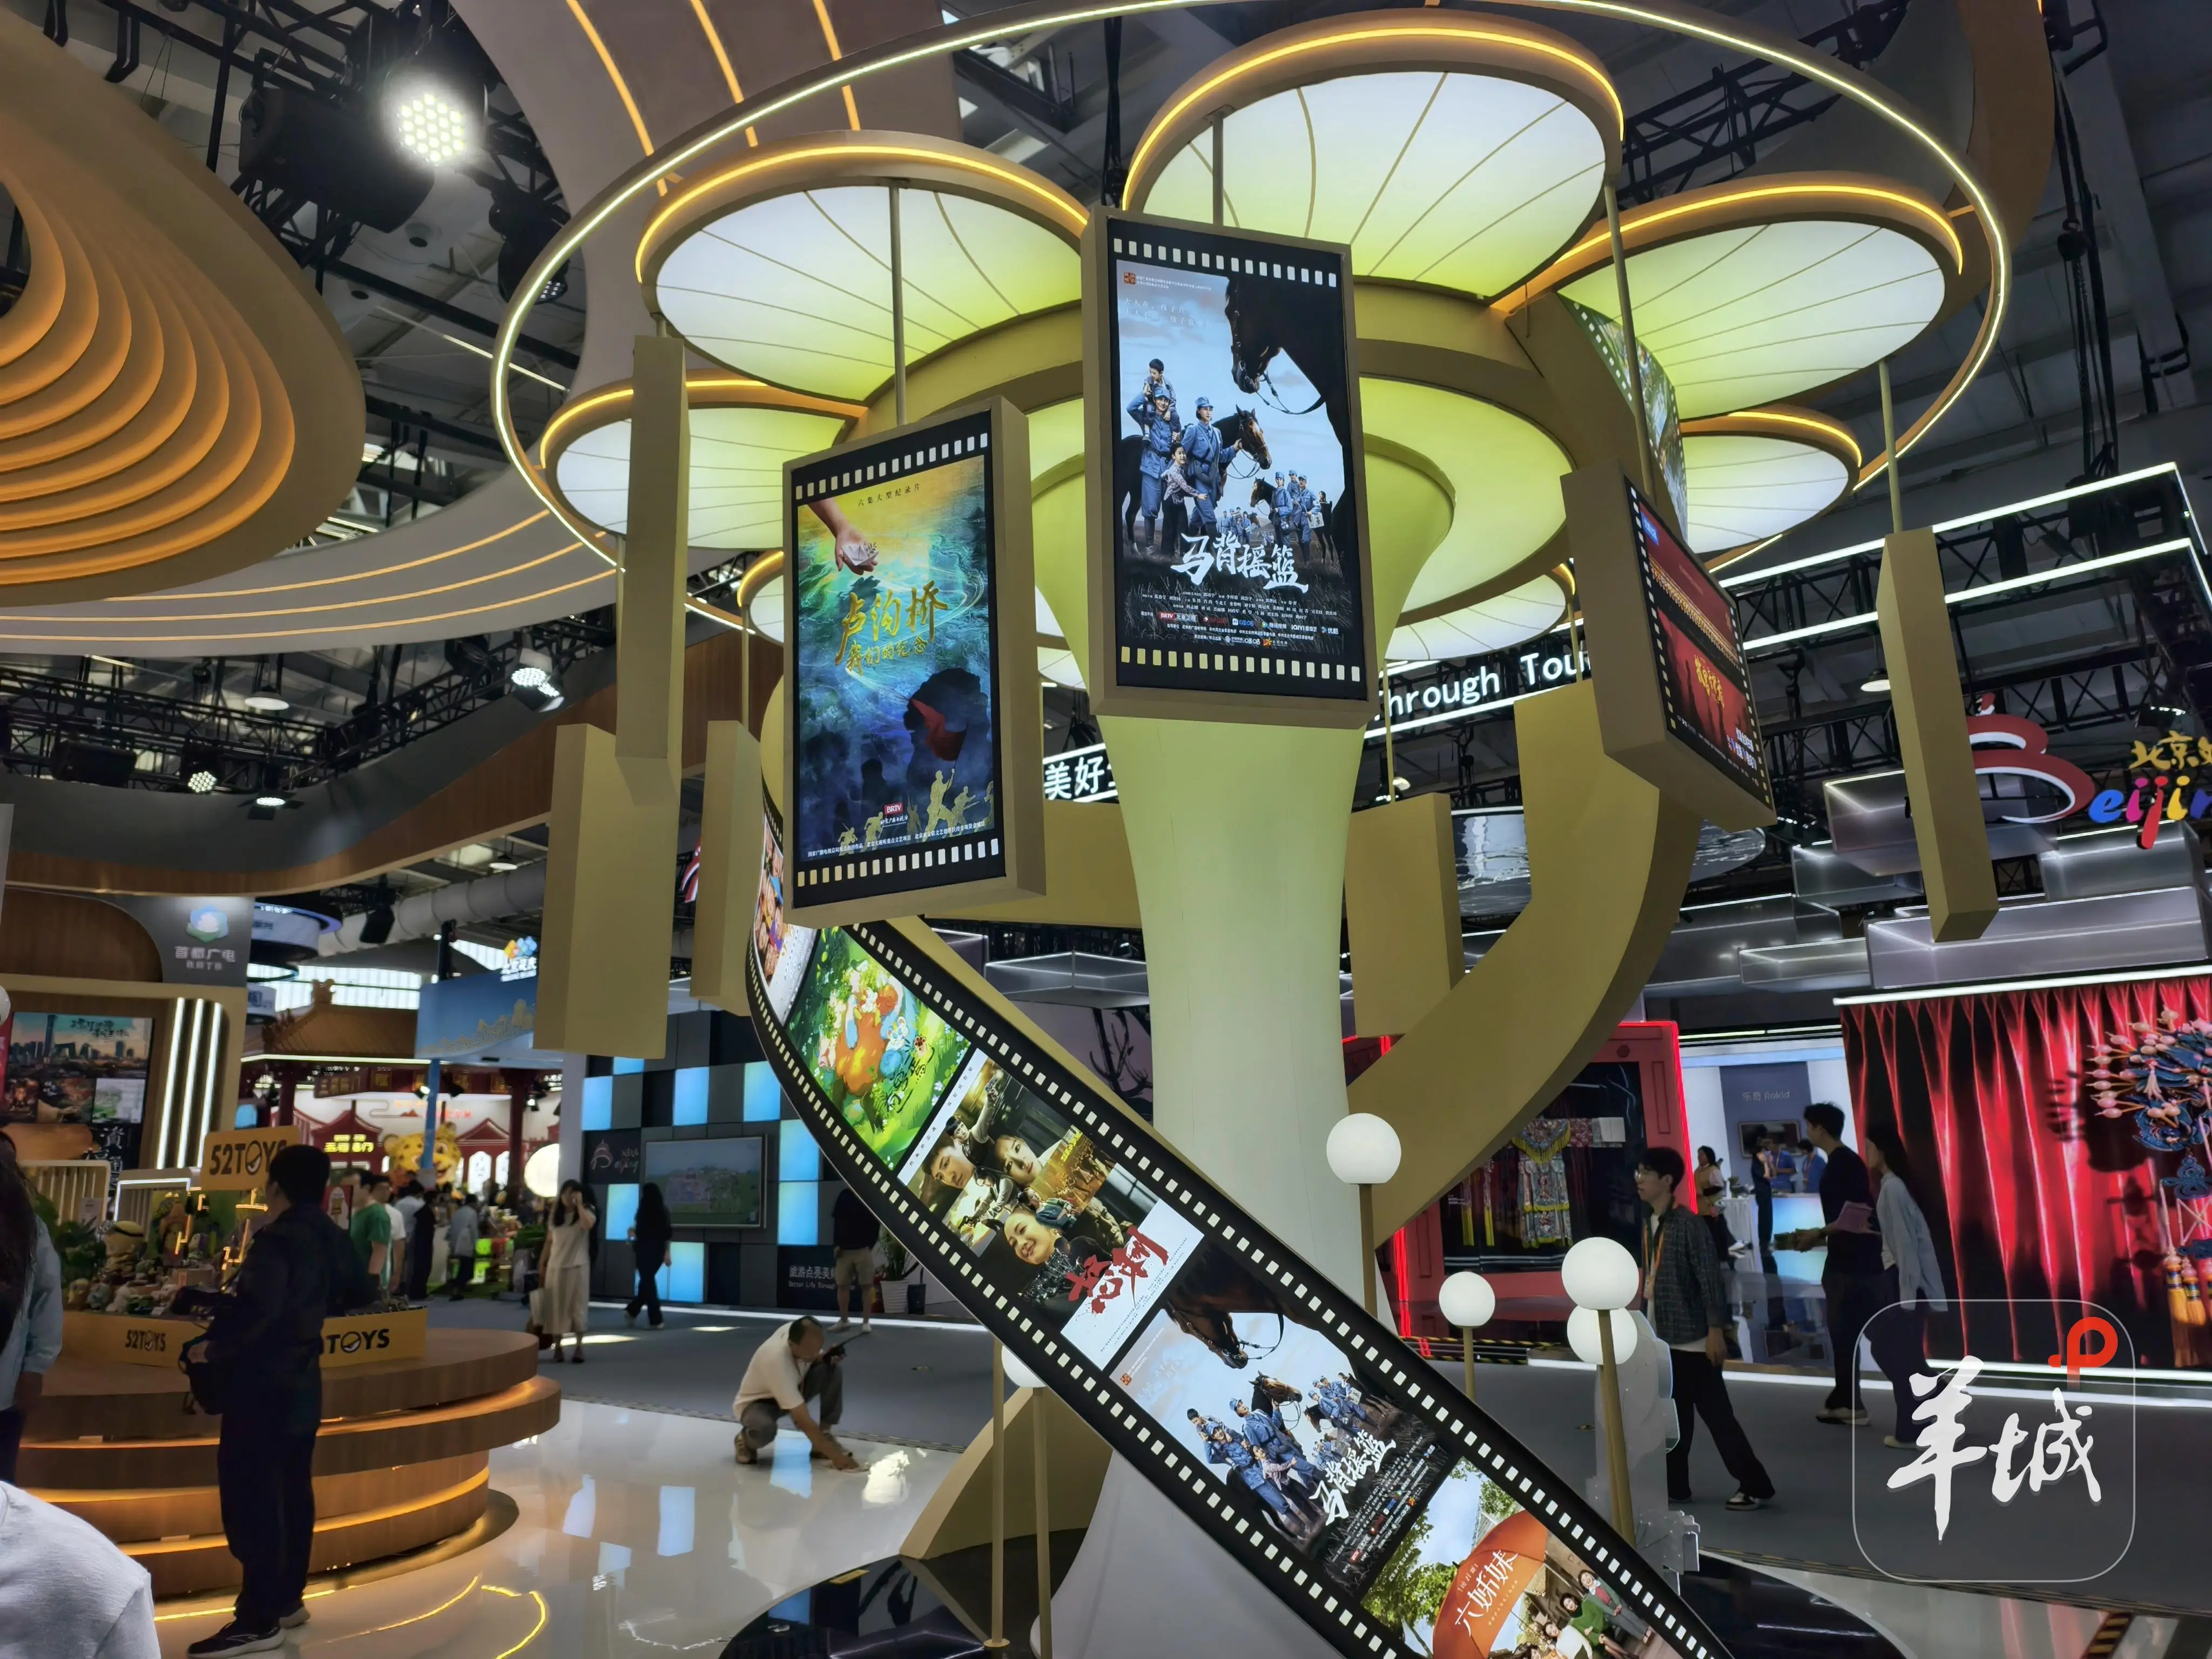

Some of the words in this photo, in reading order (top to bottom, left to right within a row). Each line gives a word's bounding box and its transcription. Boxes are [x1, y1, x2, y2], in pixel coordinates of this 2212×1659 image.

[858, 483, 920, 507] 六集大型纪录片
[1170, 531, 1309, 594] 马背摇篮
[834, 580, 948, 666] 卢沟桥
[847, 634, 929, 677] 我们的纪念
[1374, 665, 1500, 721] hrough
[1520, 651, 1590, 686] Tou
[887, 804, 902, 813] BRTV
[1764, 1091, 1790, 1101] Rokid
[125, 1330, 166, 1351] 52TOYS
[1309, 1429, 1396, 1526] 马背摇篮
[1454, 1547, 1518, 1636] 六姊妹
